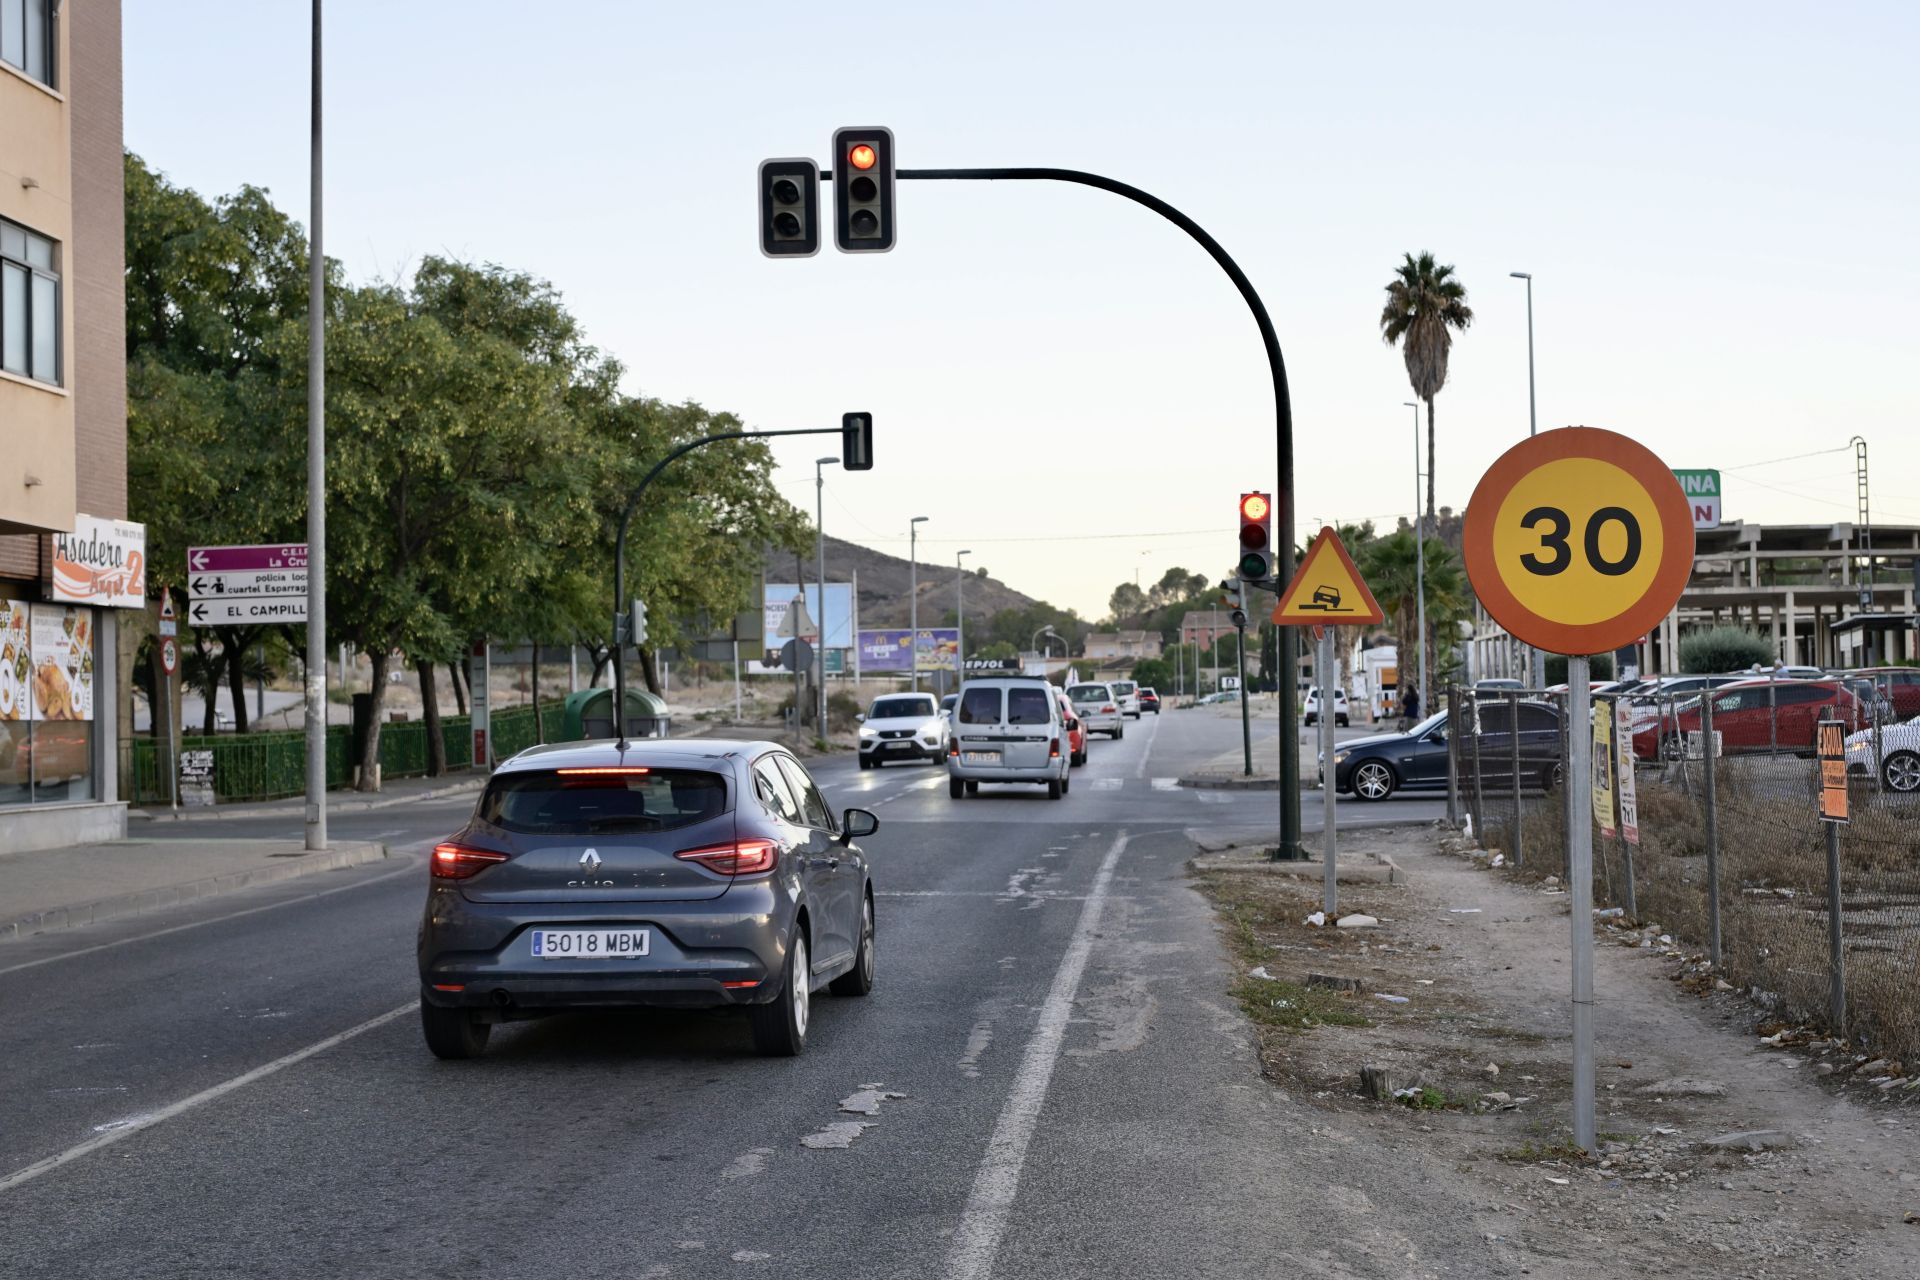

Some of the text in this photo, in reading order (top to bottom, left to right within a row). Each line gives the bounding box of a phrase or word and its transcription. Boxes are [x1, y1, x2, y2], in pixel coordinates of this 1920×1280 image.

[1676, 475, 1716, 493] INA
[56, 528, 123, 568] Asadero
[1519, 506, 1642, 576] 30
[269, 558, 282, 567] La
[126, 550, 143, 595] 2
[228, 585, 260, 593] cuartel
[227, 606, 243, 617] EL
[962, 660, 1004, 669] EPSOL
[567, 880, 614, 888] CLIO
[546, 934, 598, 952] 5018
[606, 933, 644, 952] MBM
